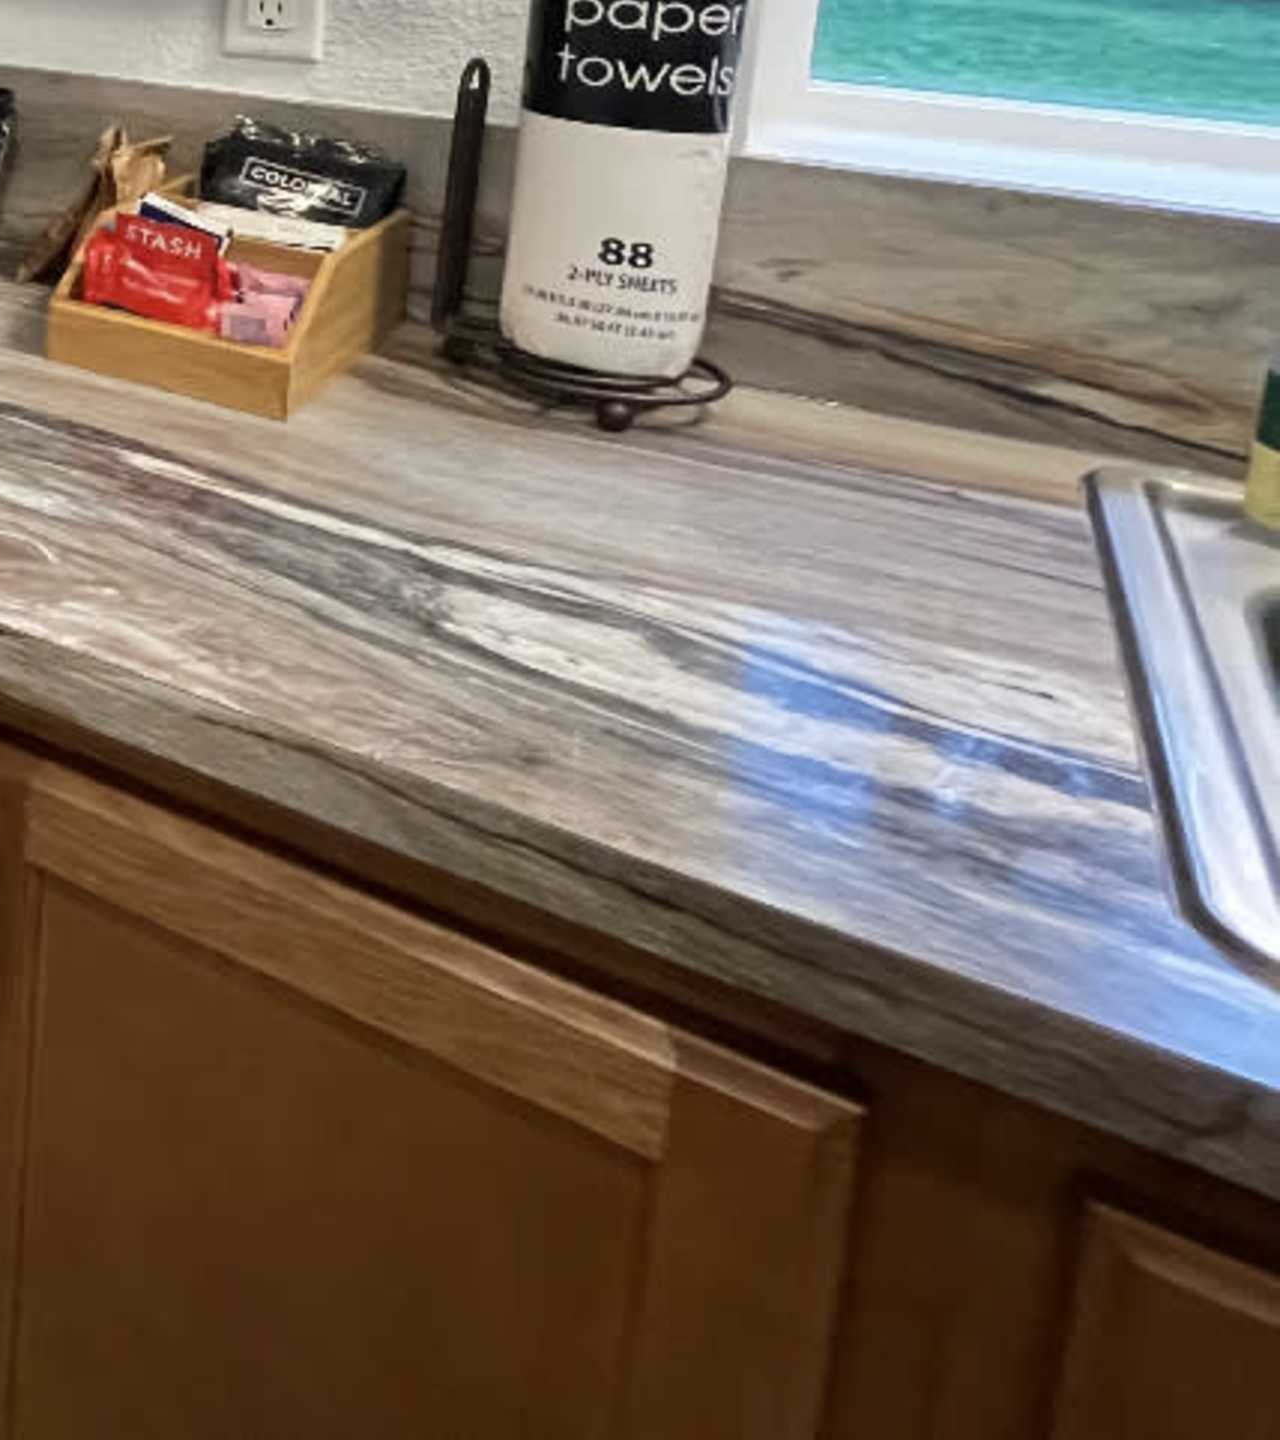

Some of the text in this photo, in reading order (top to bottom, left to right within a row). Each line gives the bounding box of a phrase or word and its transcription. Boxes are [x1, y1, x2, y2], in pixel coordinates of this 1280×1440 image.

[556, 42, 736, 96] towels
[250, 165, 353, 207] COLOAL
[124, 223, 203, 260] STASH
[597, 236, 655, 269] 88
[567, 265, 678, 295] 2-PLY SHEETS
